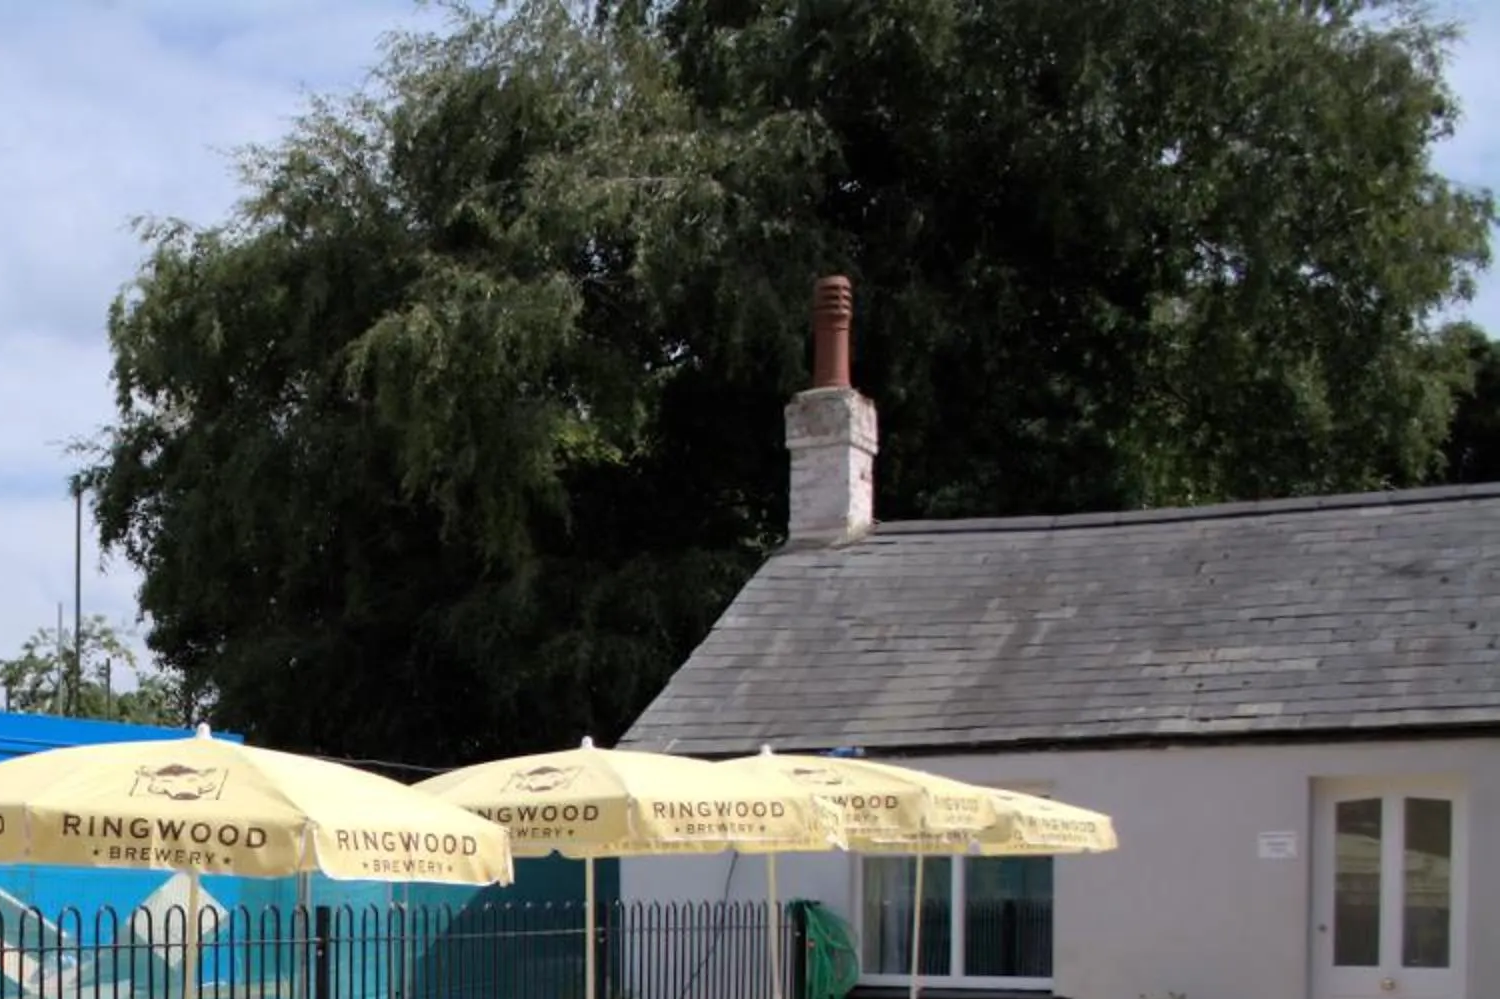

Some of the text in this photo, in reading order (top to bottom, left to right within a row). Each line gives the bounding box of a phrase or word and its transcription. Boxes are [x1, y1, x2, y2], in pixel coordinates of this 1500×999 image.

[476, 804, 599, 823] NGWOOD
[652, 801, 785, 818] RINGWOOD
[62, 813, 268, 849] RINGWOOD
[335, 829, 478, 857] RINGWOOD
[108, 845, 216, 865] BREWERY
[373, 858, 444, 874] BREWERY
